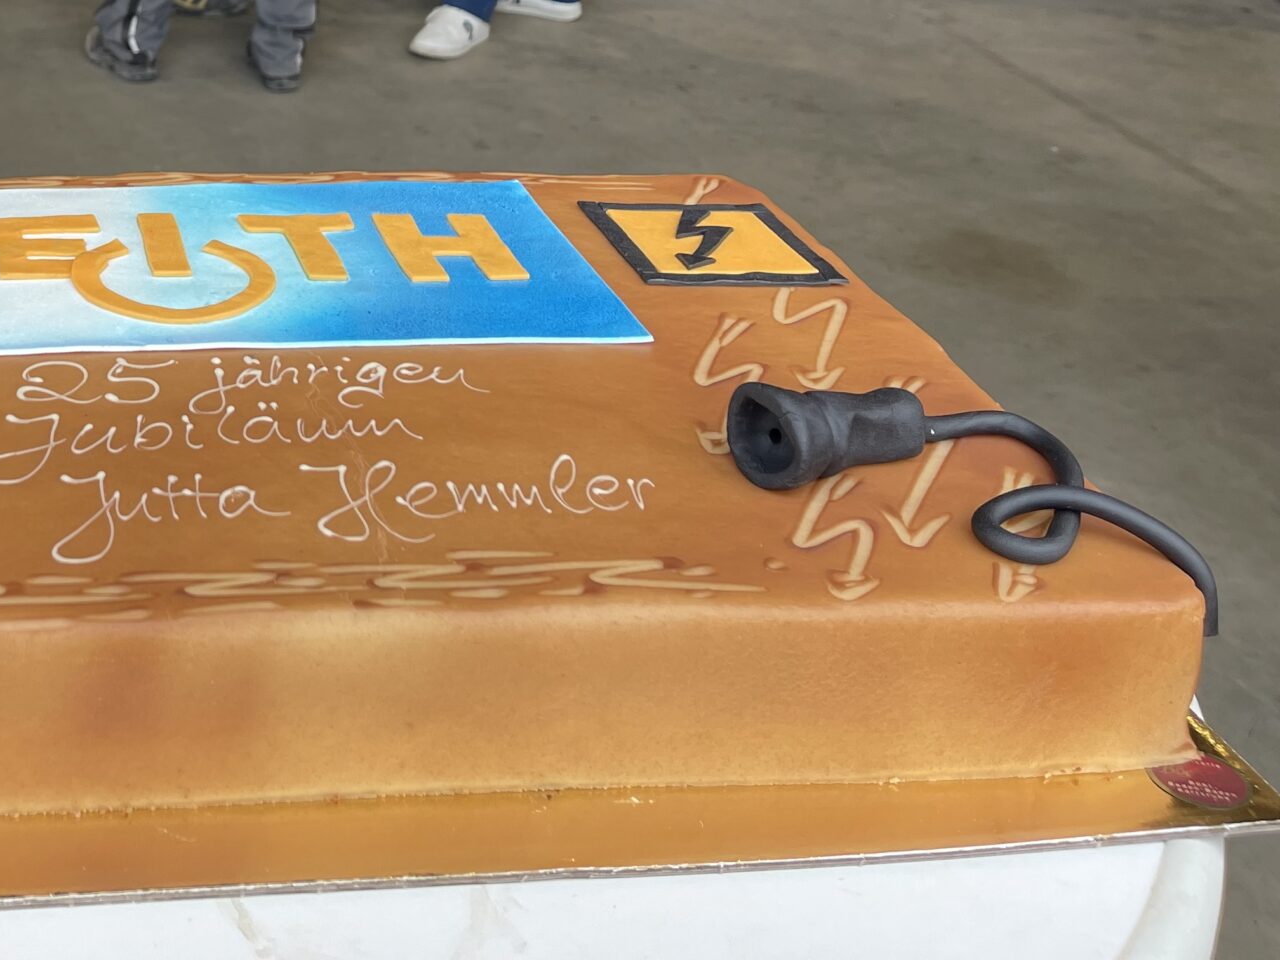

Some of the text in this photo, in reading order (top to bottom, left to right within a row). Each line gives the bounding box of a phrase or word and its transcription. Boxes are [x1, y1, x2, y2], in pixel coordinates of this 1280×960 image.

[16, 357, 178, 404] 25
[51, 470, 292, 564] Jutta
[299, 453, 655, 543] Hemmler
